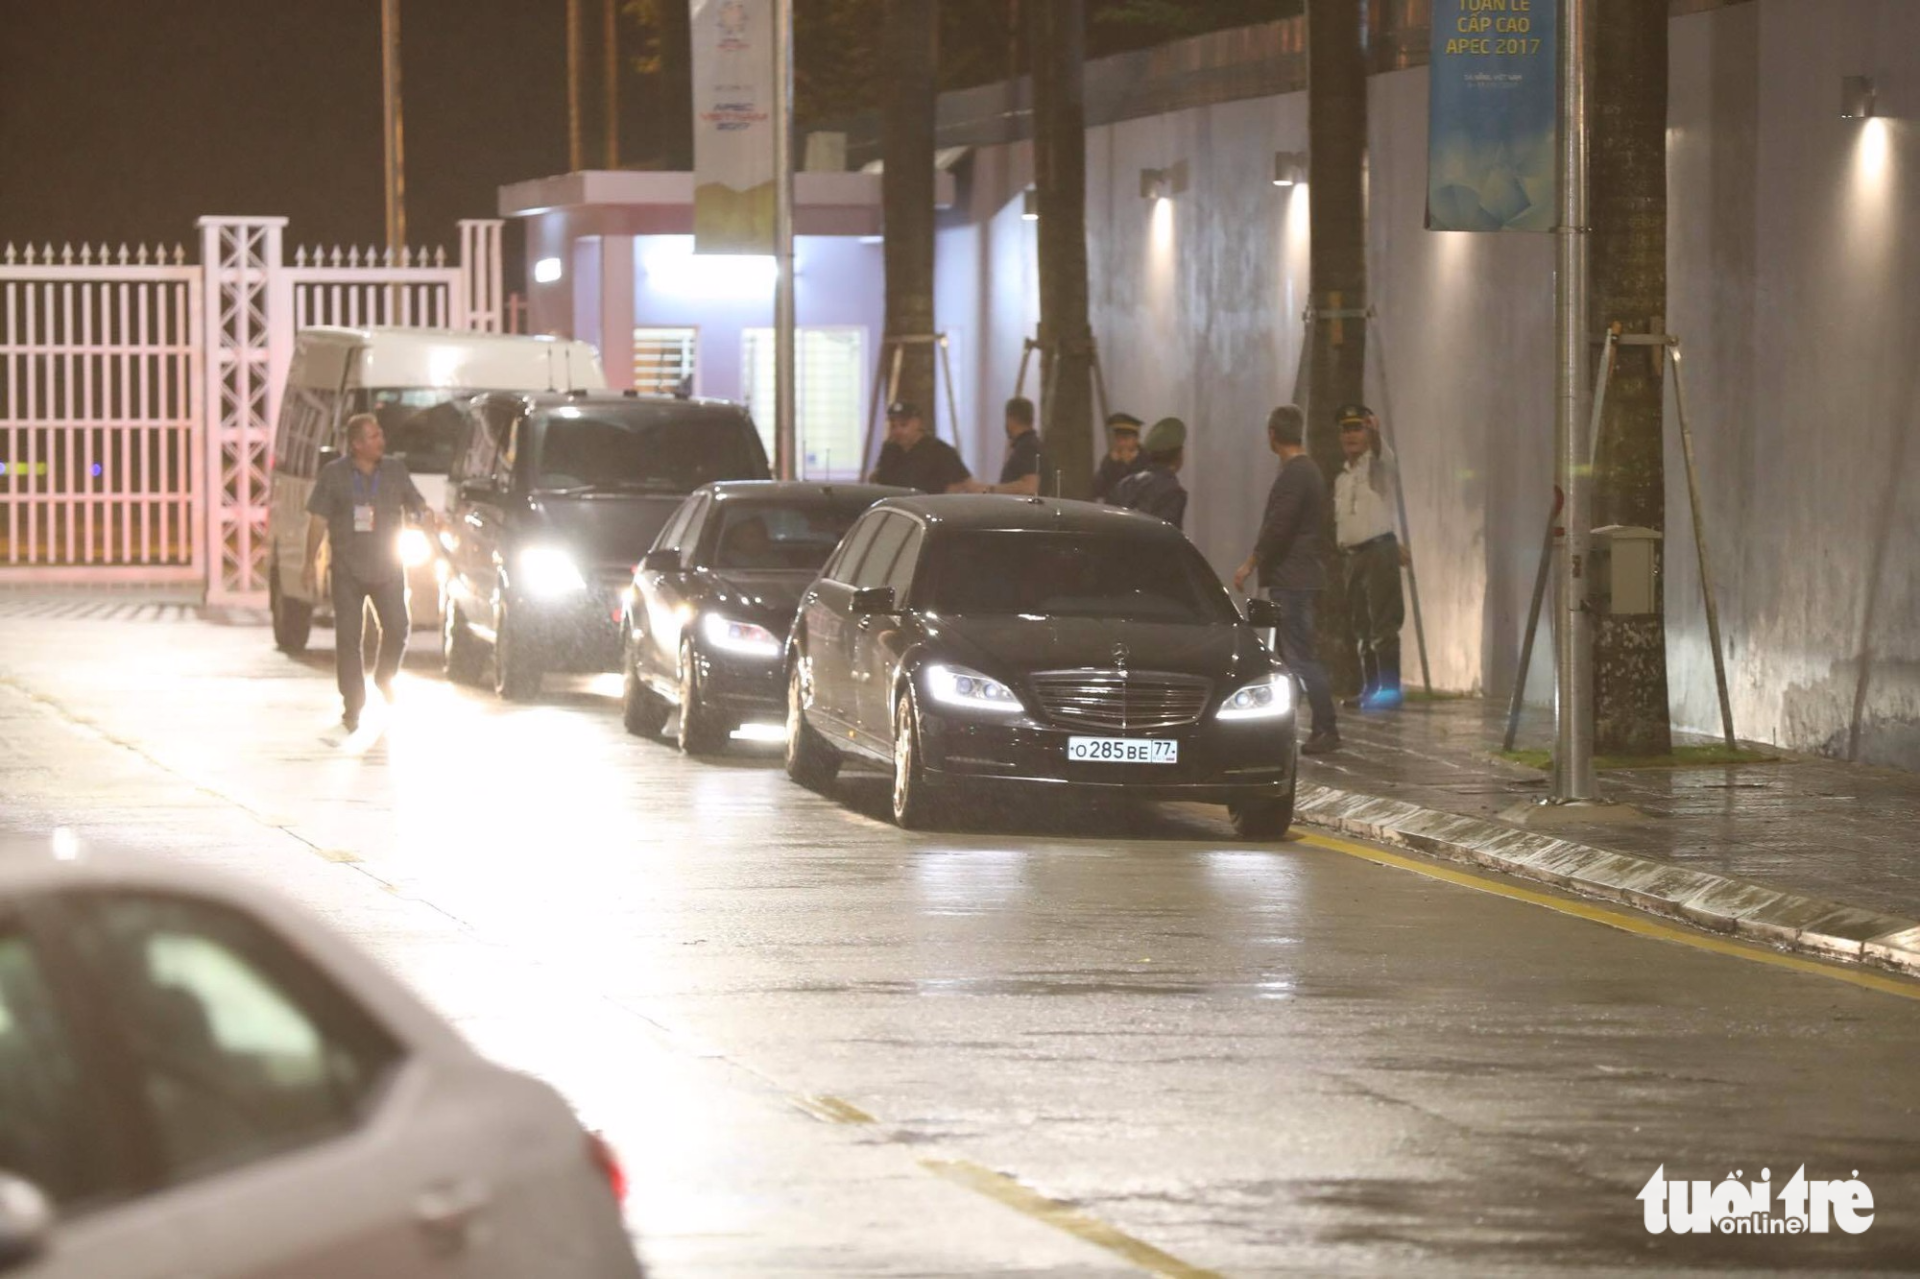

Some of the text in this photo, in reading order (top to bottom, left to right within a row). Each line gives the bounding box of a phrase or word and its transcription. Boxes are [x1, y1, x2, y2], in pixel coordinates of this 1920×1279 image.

[1457, 10, 1530, 33] CẤP CAO
[1446, 38, 1541, 54] APEC 2017
